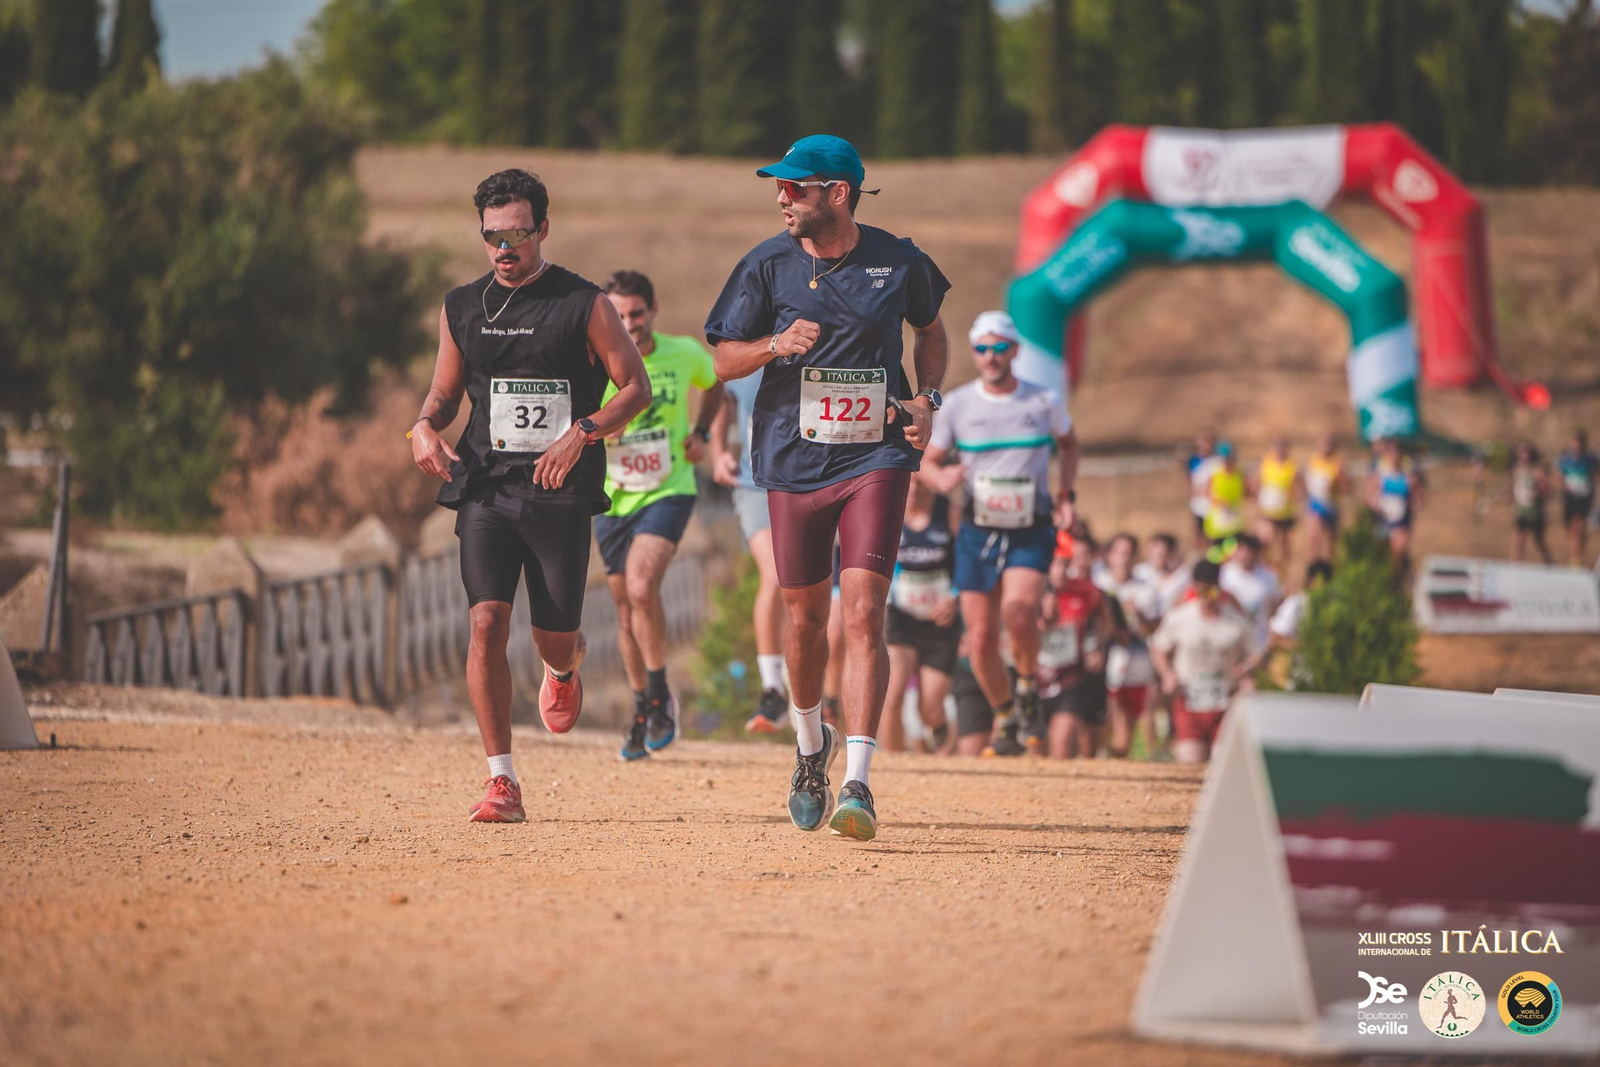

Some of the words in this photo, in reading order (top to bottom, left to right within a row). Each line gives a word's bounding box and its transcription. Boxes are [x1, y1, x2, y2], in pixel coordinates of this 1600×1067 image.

[513, 381, 550, 392] ITÁLICA
[827, 371, 867, 382] ITÁLICA
[515, 405, 548, 429] 32
[819, 396, 871, 422] 122
[620, 452, 662, 475] 508
